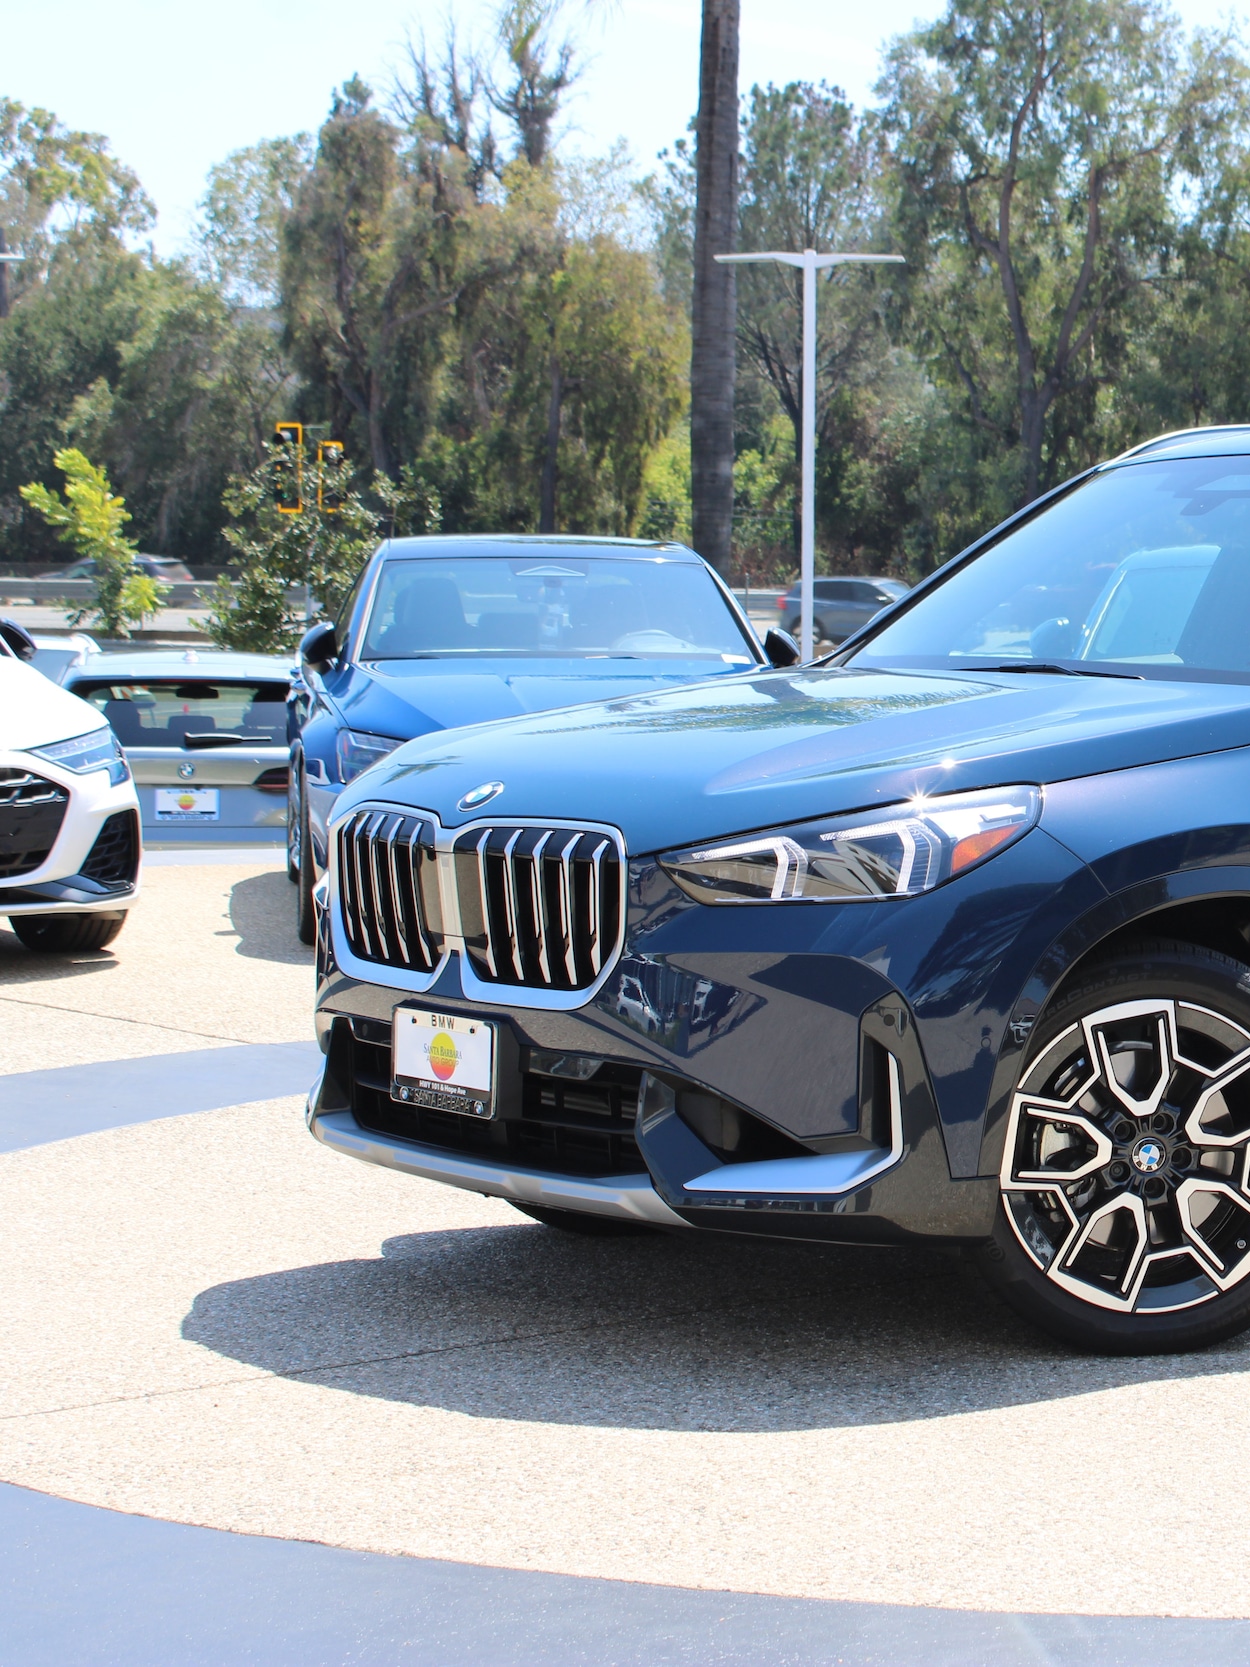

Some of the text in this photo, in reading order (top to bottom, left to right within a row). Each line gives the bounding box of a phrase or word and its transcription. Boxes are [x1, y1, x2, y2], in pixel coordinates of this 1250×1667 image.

[432, 1015, 455, 1029] BMW
[423, 1043, 463, 1059] SANTA BARBARA
